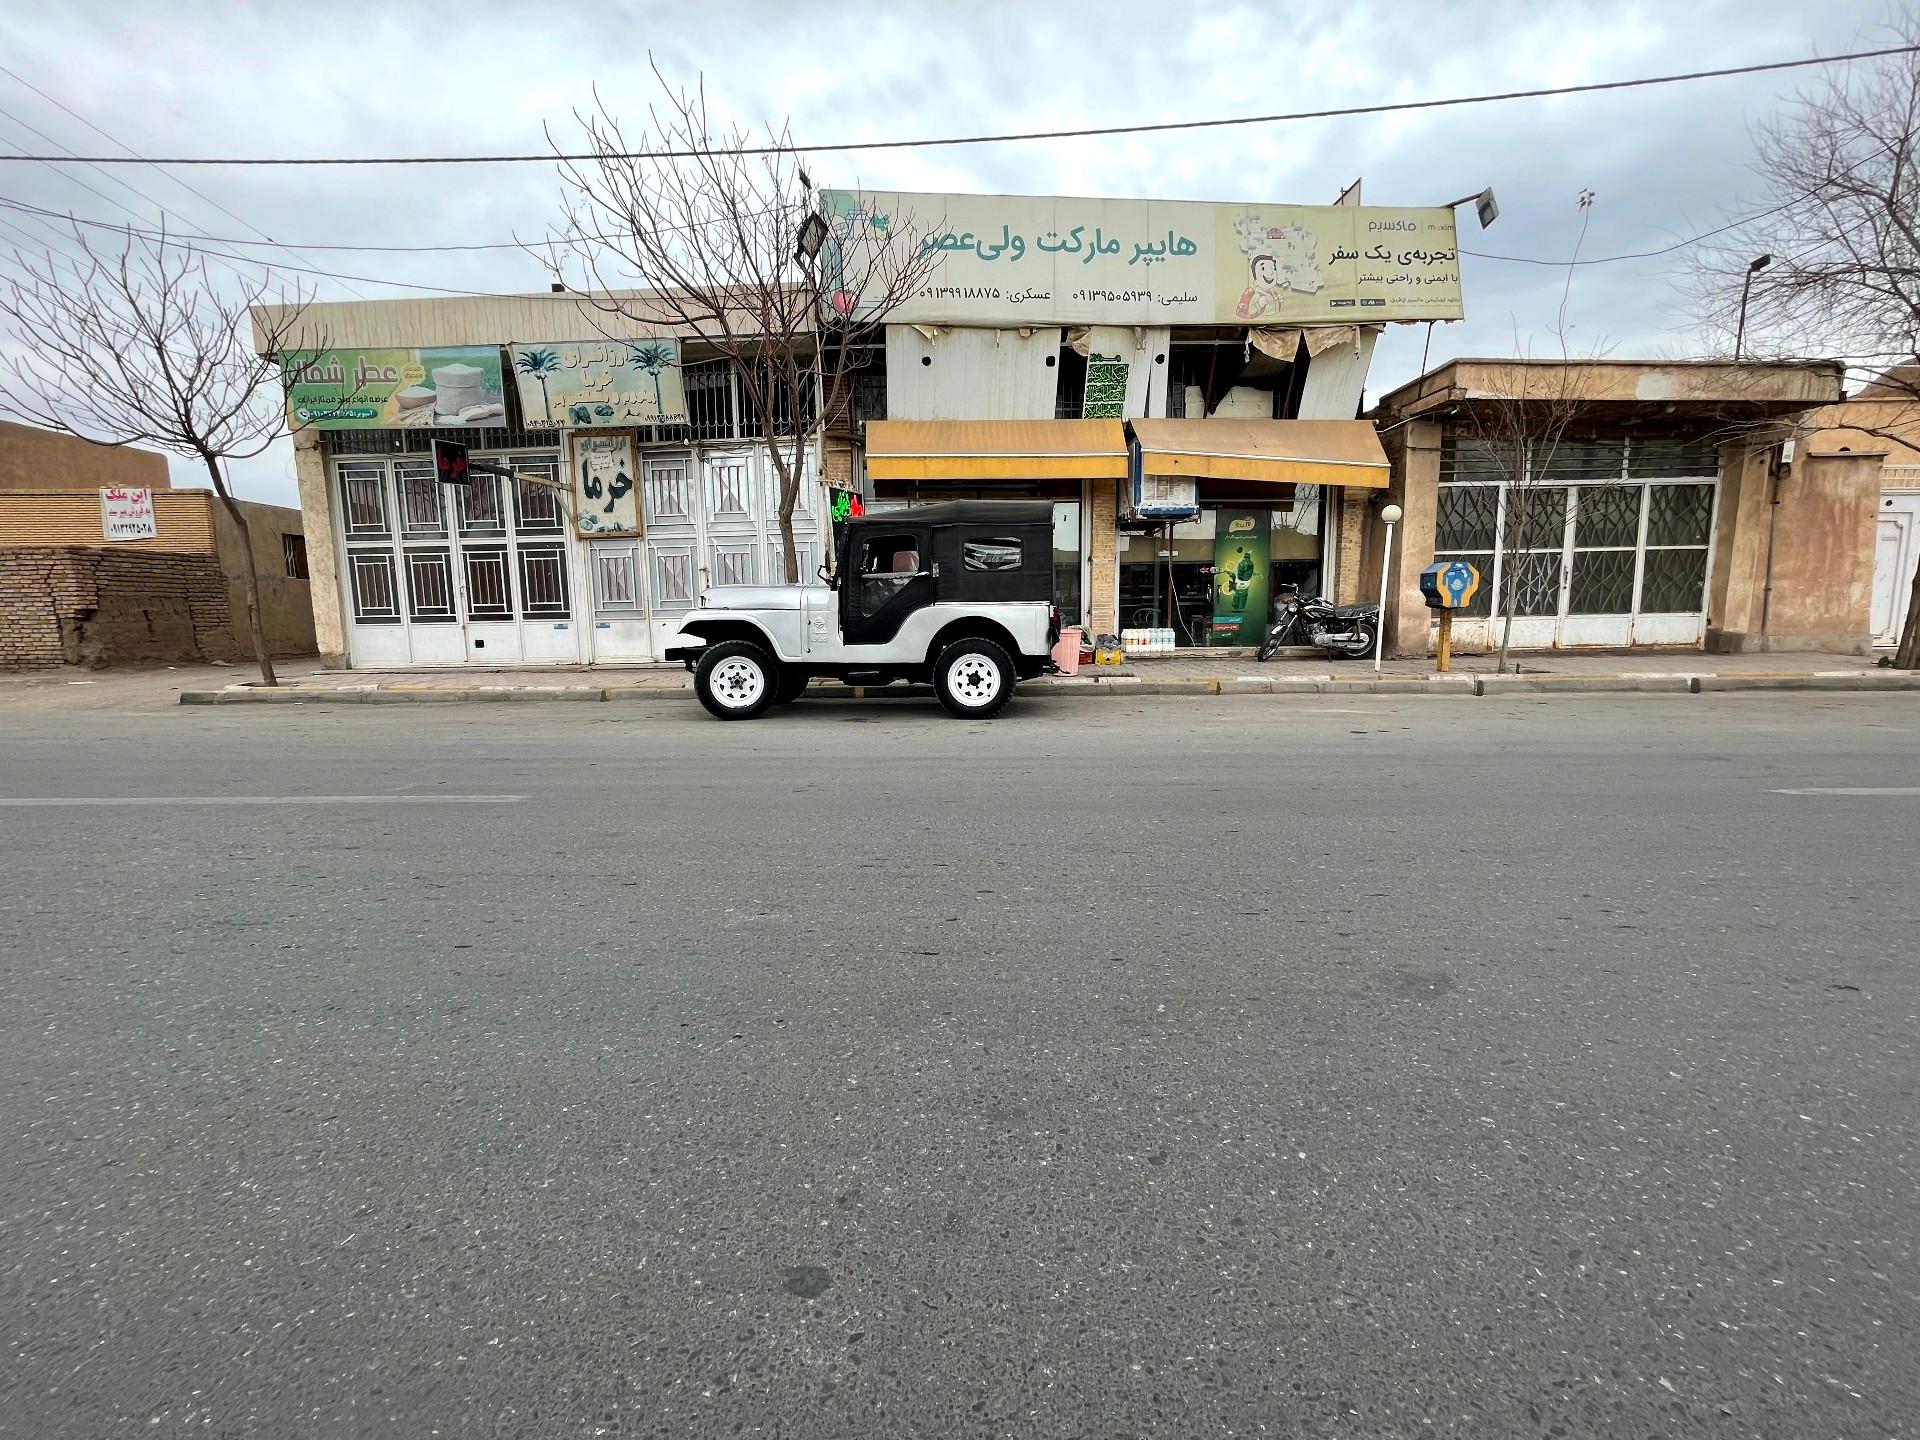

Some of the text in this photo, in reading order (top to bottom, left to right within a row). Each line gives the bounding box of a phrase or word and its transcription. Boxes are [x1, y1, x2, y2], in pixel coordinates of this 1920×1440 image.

[1368, 220, 1417, 233] ماکسیم
[1036, 225, 1121, 265] مارکت
[1127, 230, 1198, 267] هایپر
[1364, 244, 1392, 263] یک
[1328, 245, 1359, 265] سفر
[1357, 273, 1458, 285] با ایمنی و راحتی بیشتر
[919, 287, 1051, 303] عسکری: ۰۹۱۳۹۹۱۸۸۷۵
[1073, 289, 1198, 306] سلیمی: ۰۹۱۳۹۵۰۵۹۳۹
[287, 354, 399, 392] عطر شمال
[582, 459, 634, 512] خرما
[106, 489, 148, 504] این ملک
